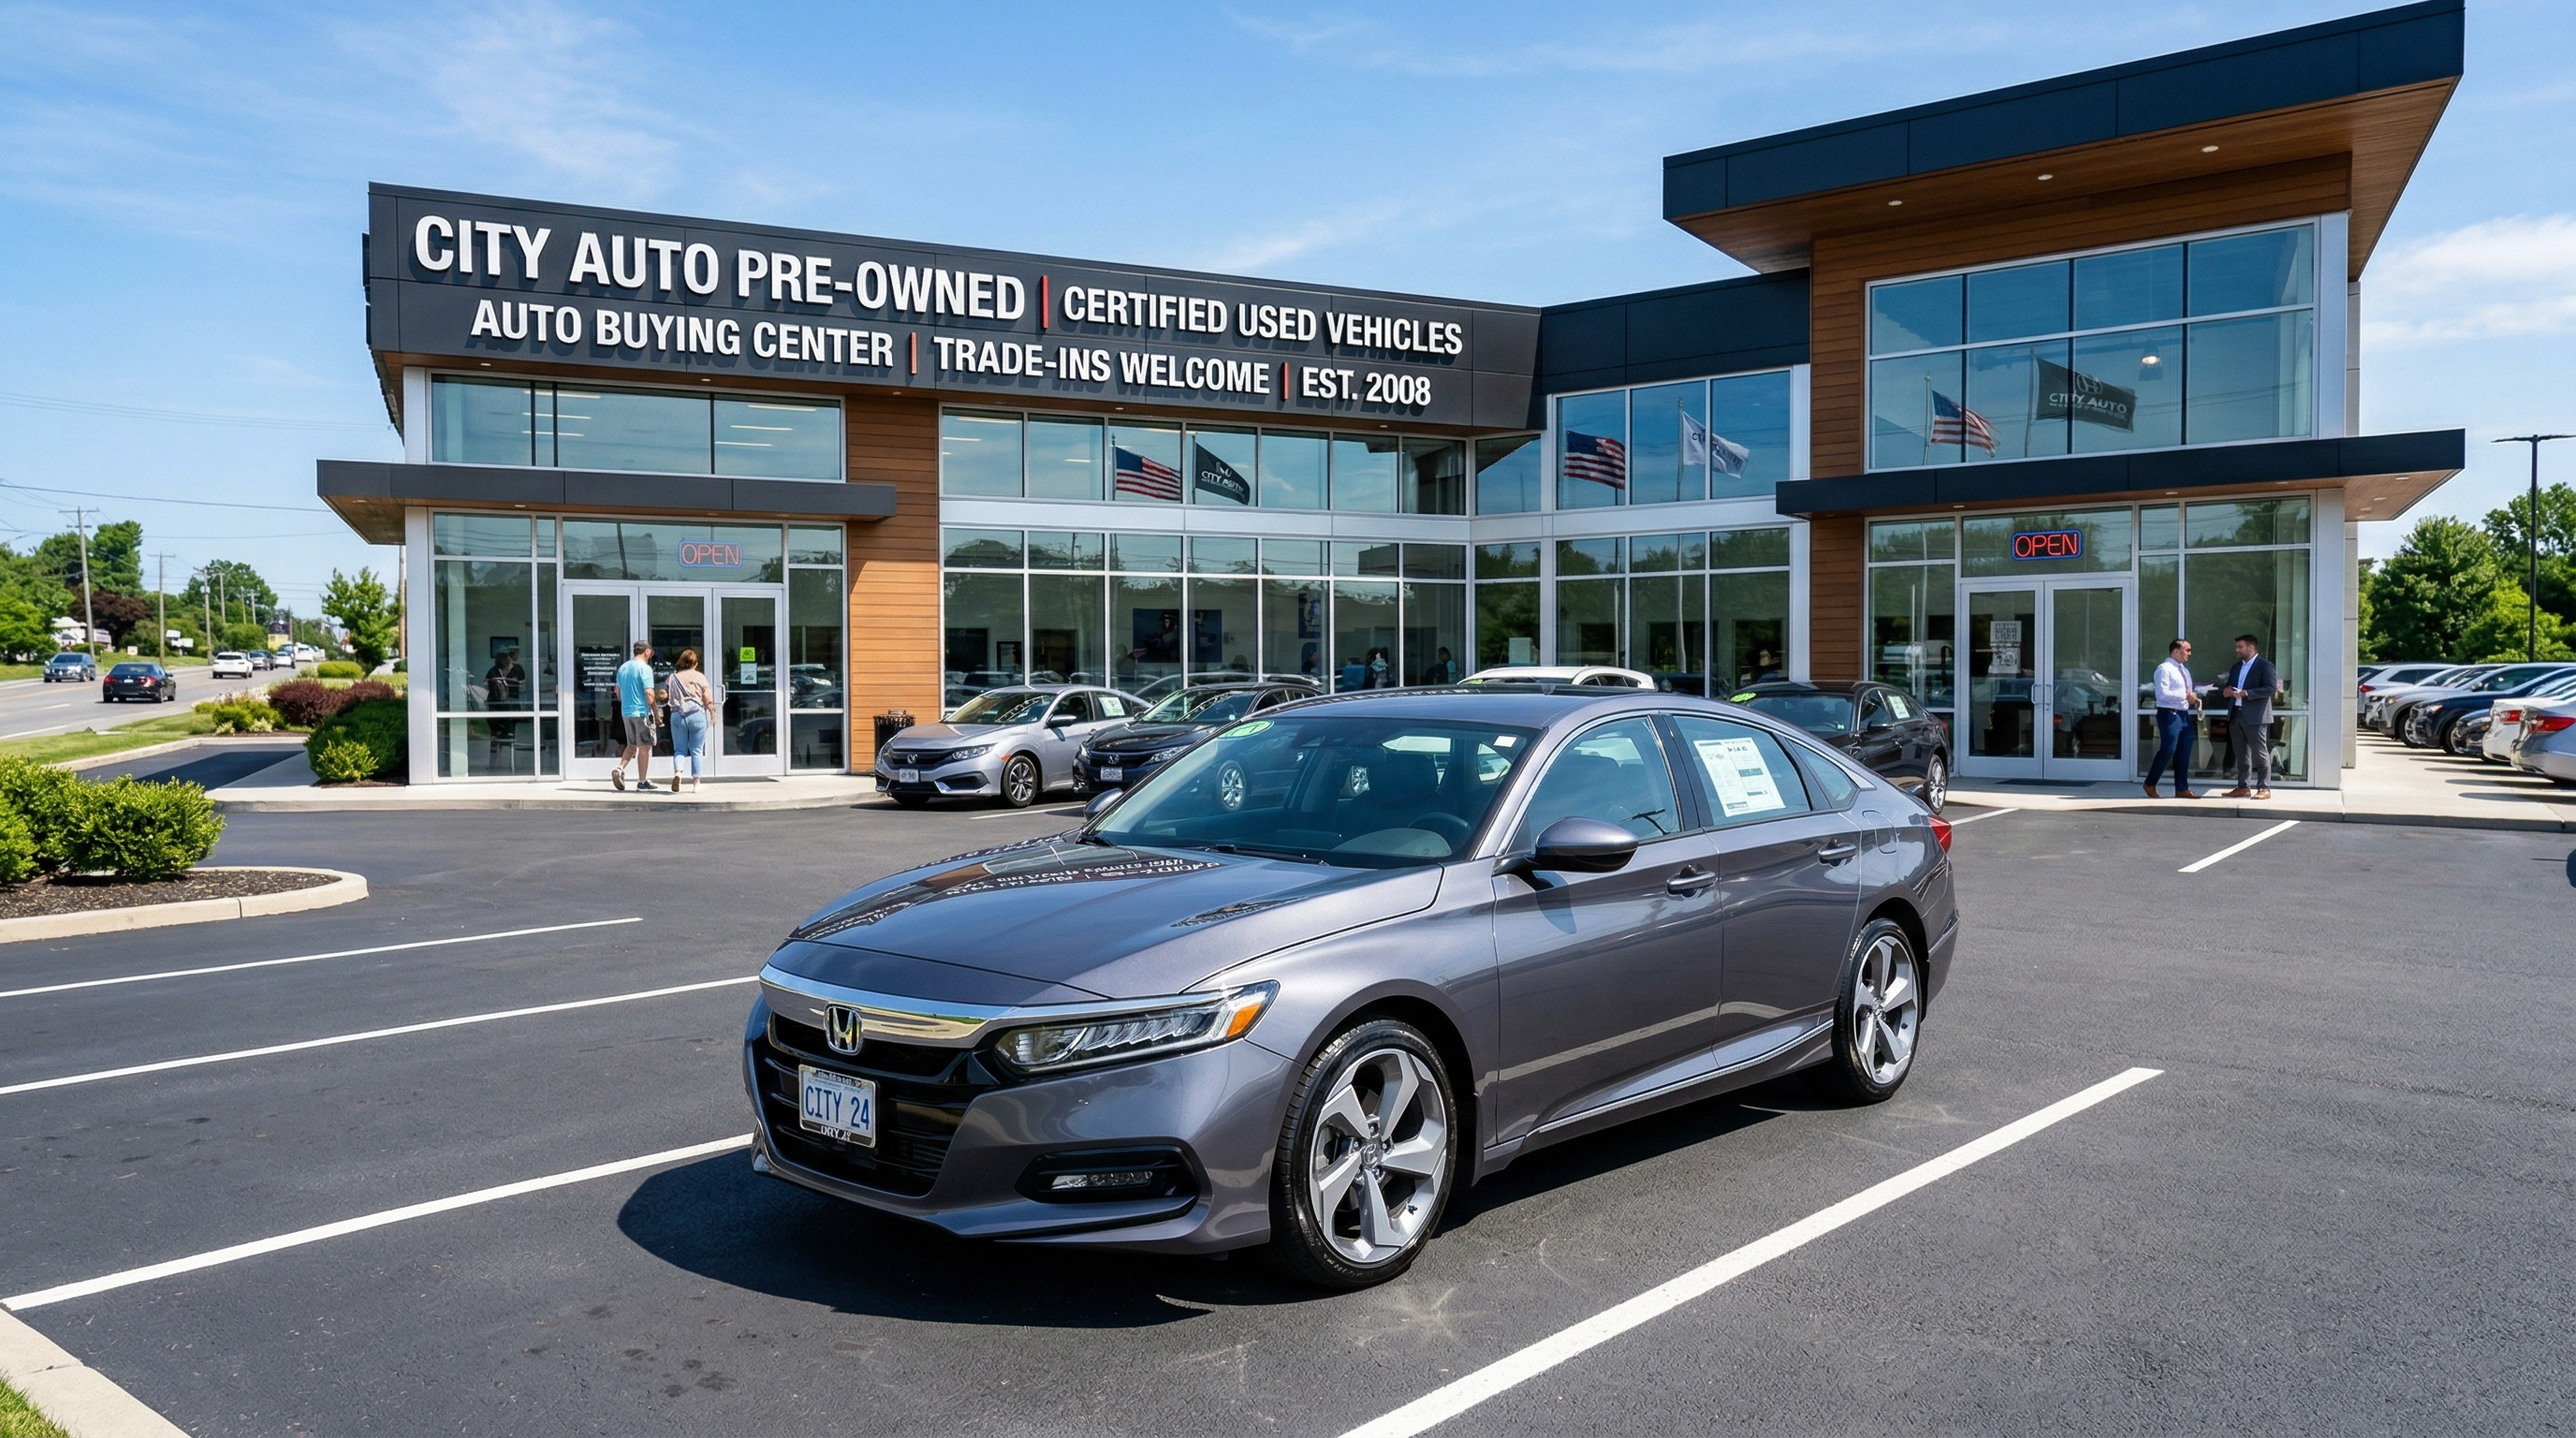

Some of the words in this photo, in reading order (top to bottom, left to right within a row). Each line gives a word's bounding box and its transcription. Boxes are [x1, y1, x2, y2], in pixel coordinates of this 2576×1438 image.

[415, 214, 552, 279] CITY
[568, 231, 720, 295] AUTO
[738, 248, 1027, 320] PRE-OWNED
[1063, 285, 1228, 334] CERTIFIED
[1237, 301, 1318, 343] USED
[1325, 311, 1464, 356] VEHICLES
[470, 299, 583, 345] AUTO
[595, 308, 741, 356] BUYING
[753, 321, 895, 368] CENTER
[933, 335, 1112, 383] TRADE-INS
[1119, 351, 1271, 395] WELCOME
[1302, 366, 1358, 401] EST.
[1366, 372, 1432, 406] 2008
[681, 543, 739, 565] OPEN
[2014, 533, 2078, 557] OPEN
[805, 1085, 842, 1124] CITY
[850, 1095, 871, 1131] 24
